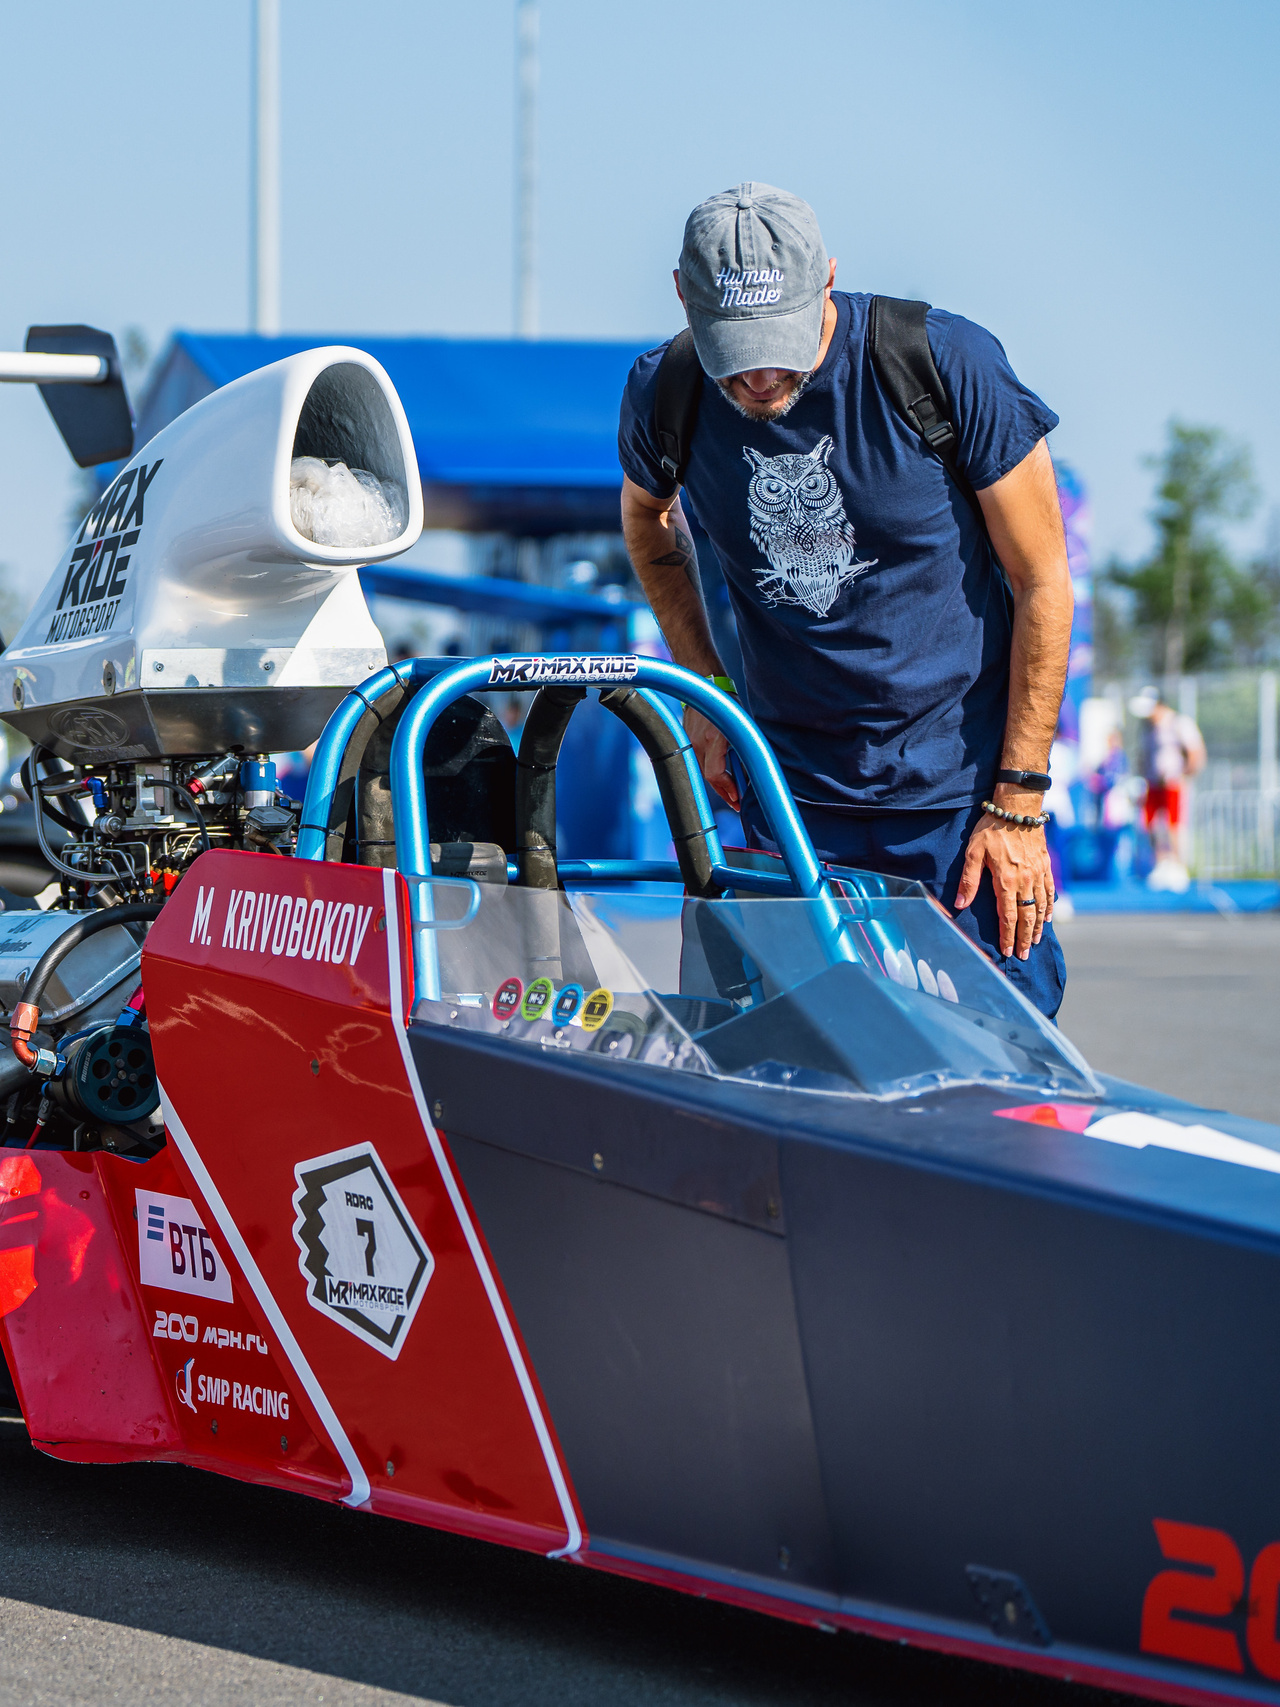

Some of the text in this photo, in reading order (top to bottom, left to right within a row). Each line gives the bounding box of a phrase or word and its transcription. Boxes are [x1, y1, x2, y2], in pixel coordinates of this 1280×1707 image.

[715, 267, 784, 287] Human
[720, 285, 781, 308] Made
[76, 458, 164, 545] MAX
[56, 529, 141, 611] RIDE
[44, 599, 121, 644] MOTORSPORT
[537, 673, 634, 682] MOTORSPORT
[190, 886, 373, 966] M. KRIVOBOKOV
[344, 1191, 374, 1211] RDRC
[168, 1221, 217, 1282] ВТБ
[355, 1217, 377, 1278] 7
[153, 1310, 198, 1343] 200
[353, 1300, 404, 1313] MOTORSPORT
[197, 1374, 290, 1420] SMP RACING
